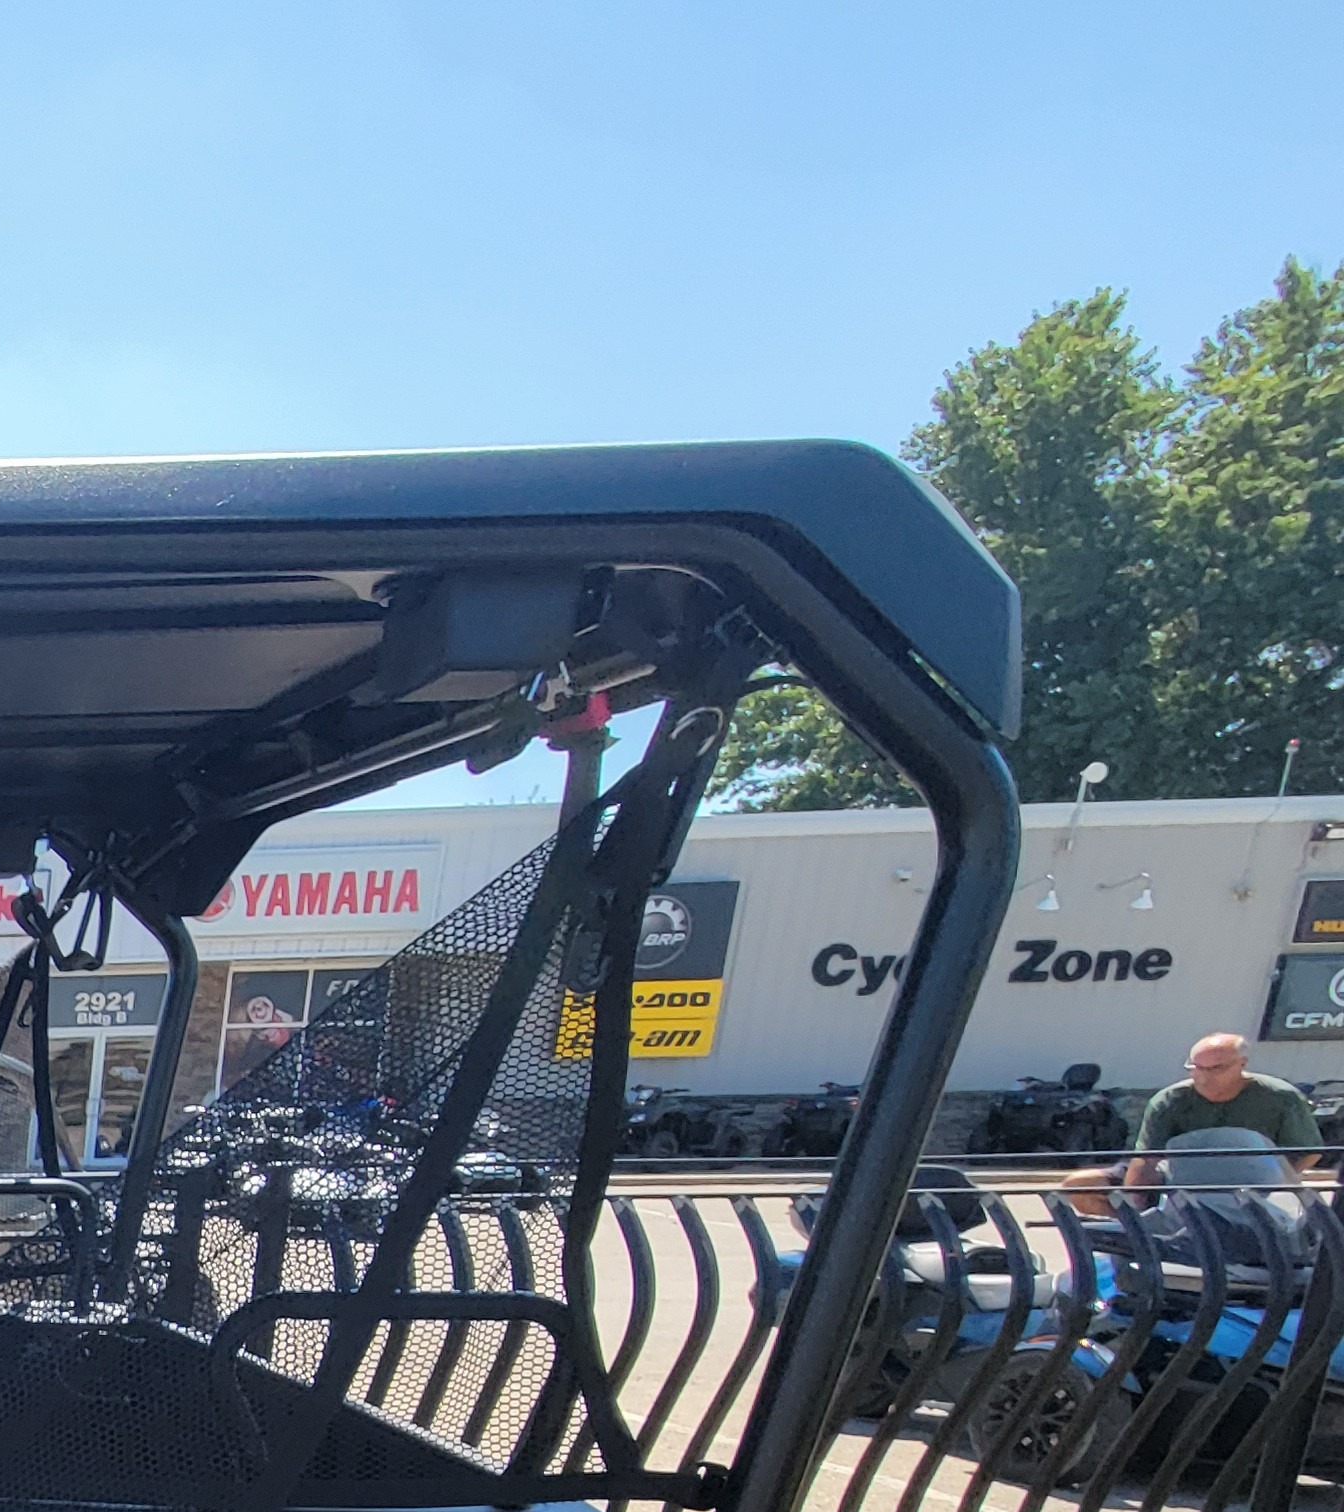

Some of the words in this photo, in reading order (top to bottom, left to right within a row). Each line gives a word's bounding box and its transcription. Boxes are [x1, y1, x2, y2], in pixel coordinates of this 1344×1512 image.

[241, 869, 419, 917] YAMAHA
[643, 933, 687, 946] BRP
[1008, 939, 1173, 983] Zone
[74, 991, 135, 1011] 2921
[1285, 1012, 1344, 1029] CFM
